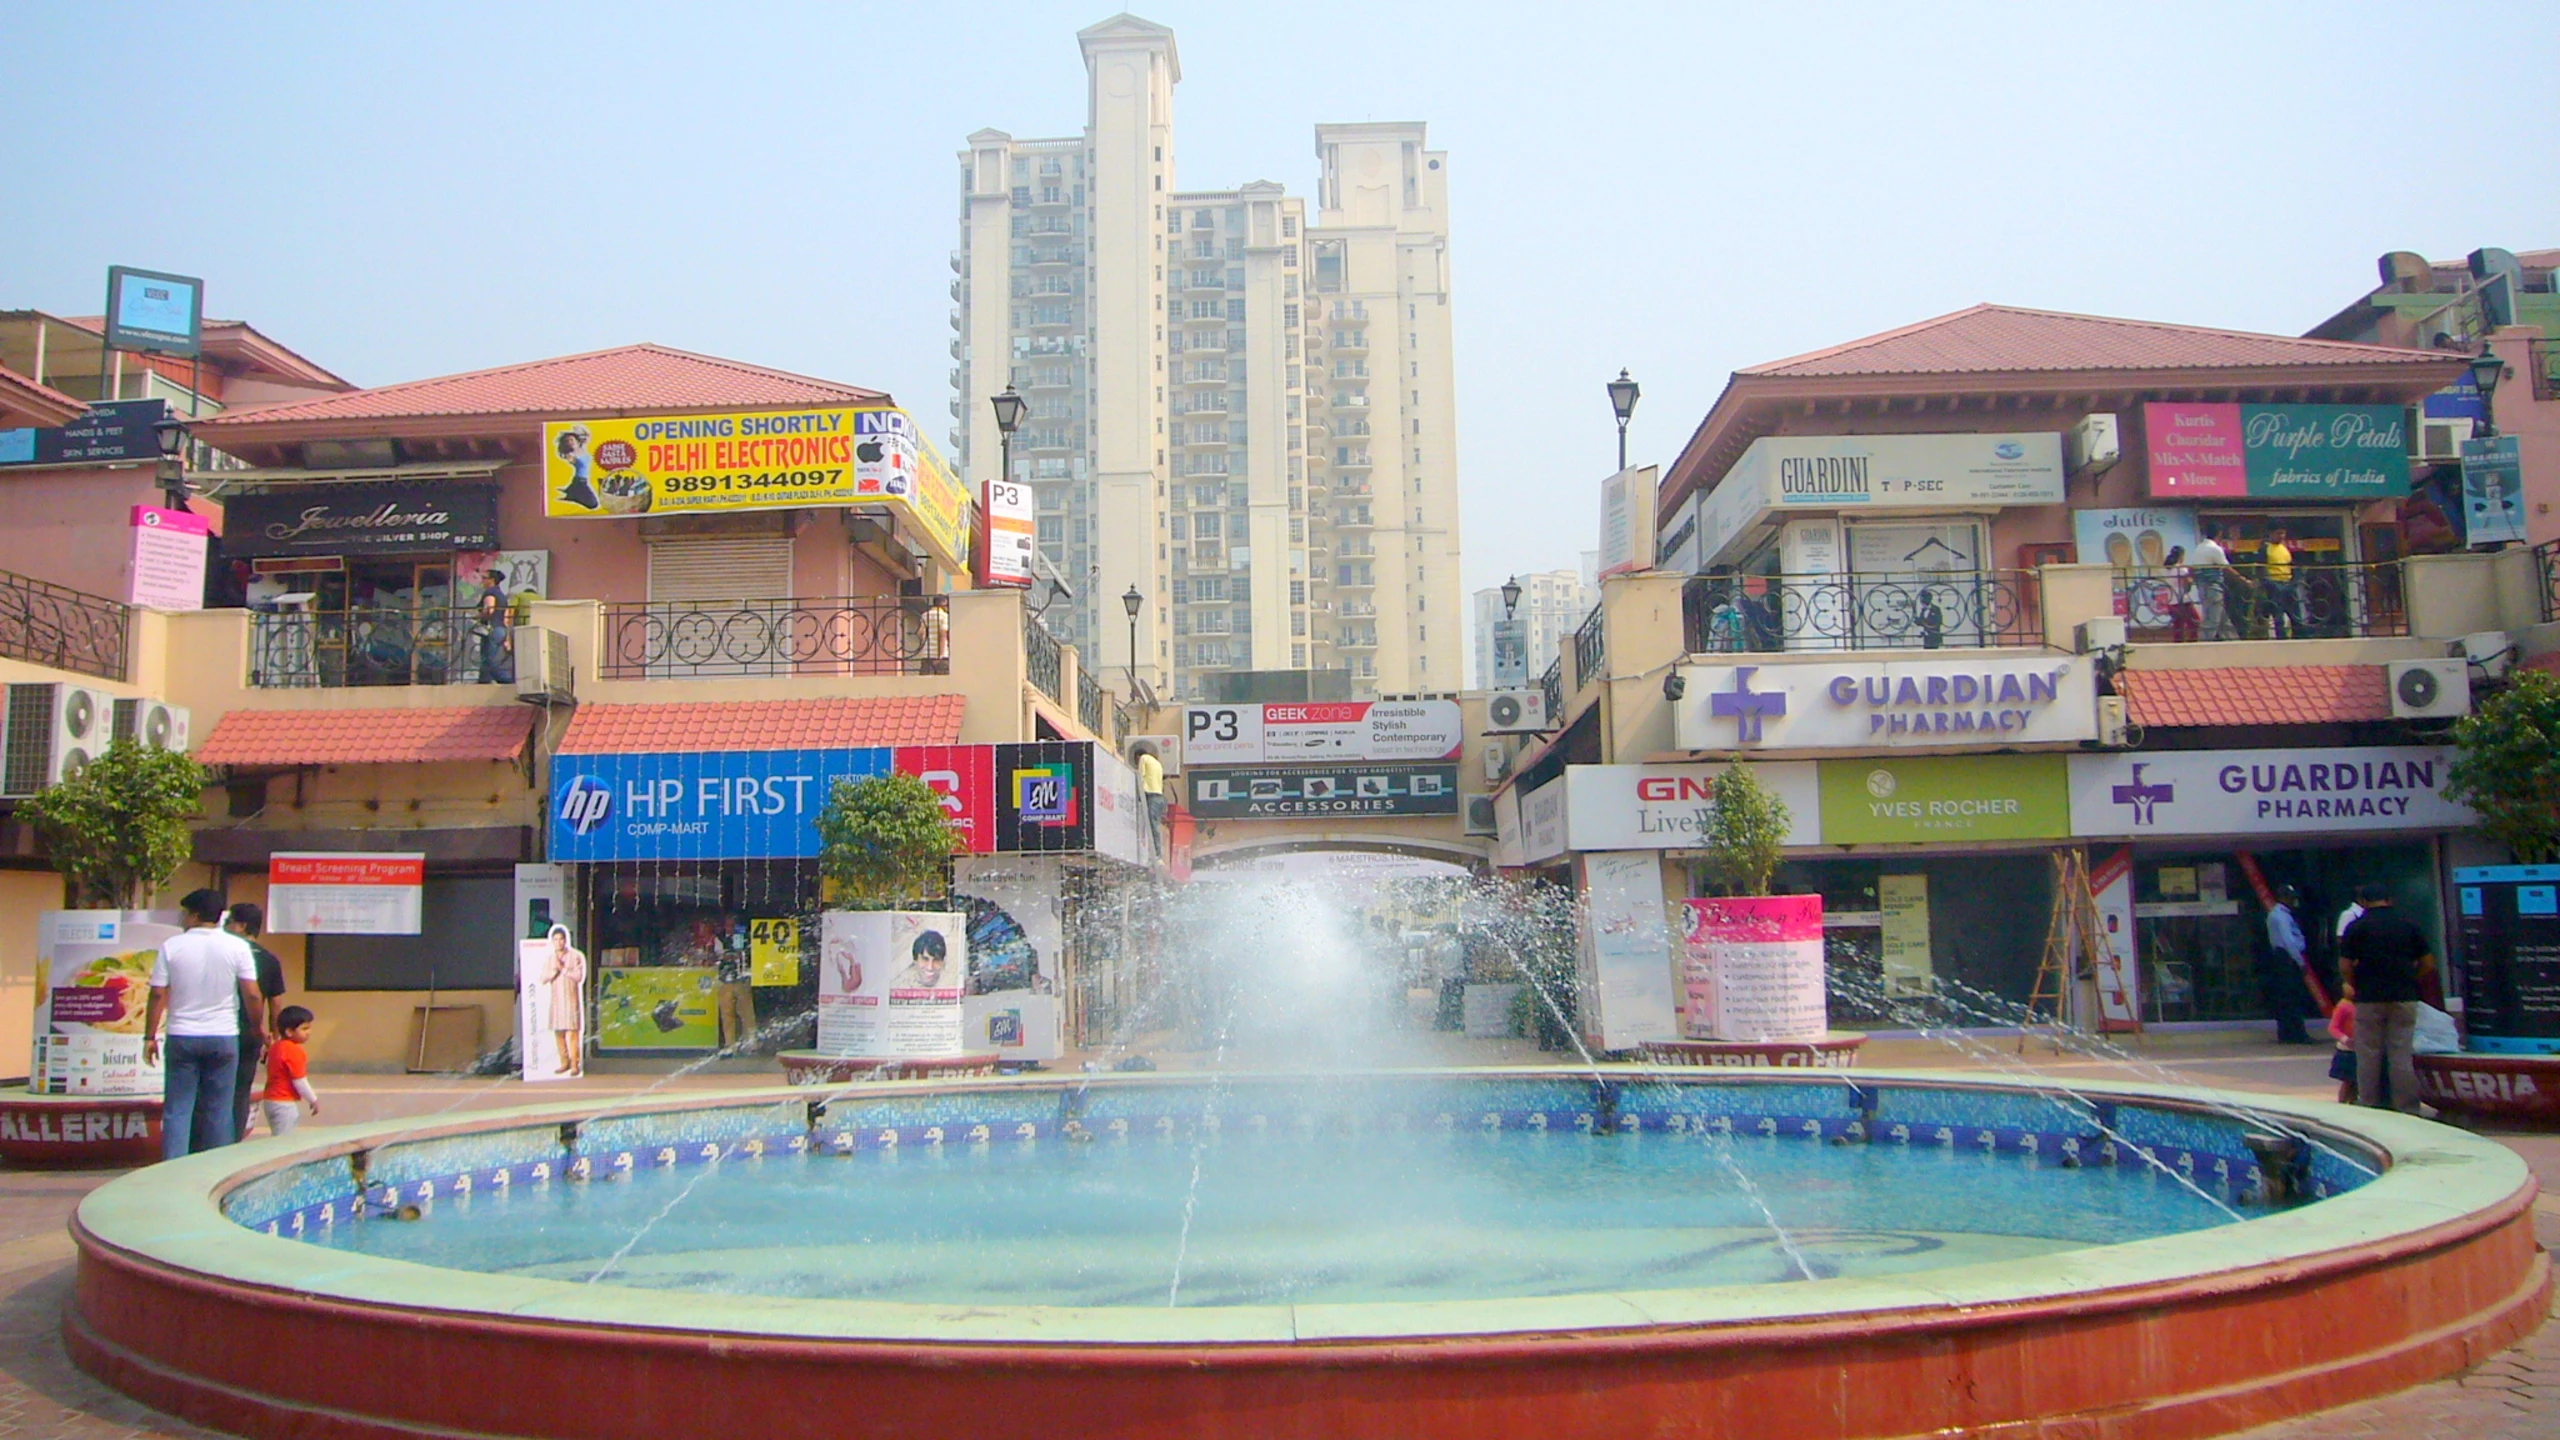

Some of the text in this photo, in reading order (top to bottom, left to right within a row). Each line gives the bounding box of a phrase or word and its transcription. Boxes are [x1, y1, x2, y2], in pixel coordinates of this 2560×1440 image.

[635, 414, 841, 440] OPENING SHORTLY
[2174, 413, 2216, 427] Kurtis
[65, 428, 95, 437] HANDS
[2246, 412, 2400, 460] Purple Petals
[63, 446, 125, 457] SKIN SERVICES
[649, 436, 851, 473] DELHI ELECTRONICS
[2154, 452, 2241, 467] Mix-N-Match
[665, 469, 843, 492] 9891344097
[1781, 456, 1870, 494] GUARDINI
[2182, 472, 2217, 486] More
[2270, 468, 2386, 487] fabrics of India
[993, 484, 1019, 505] P3
[266, 503, 449, 540] Jewelleria
[420, 532, 450, 542] SHOP
[1828, 672, 2057, 706] GUARDIAN
[1266, 706, 1351, 720] GEEK zone
[1372, 707, 1426, 718] Irresistible
[1188, 710, 1239, 742] P3
[1372, 720, 1407, 731] Stylish
[1870, 710, 2032, 734] PHARMACY
[1188, 742, 1255, 751] paper print pens
[1372, 733, 1447, 743] Contemporary
[2219, 760, 2434, 793] GUARDIAN
[560, 775, 611, 836] hp
[626, 775, 814, 818] HP FIRST
[1249, 800, 1395, 813] ACCESSORIES
[1869, 799, 2018, 817] YVES ROCHER
[2258, 796, 2409, 818] PHARMACY
[1021, 814, 1067, 823] COMP-MART
[626, 821, 709, 836] COMP-MART
[278, 862, 416, 876] Breast Screening Program
[752, 921, 790, 946] 40
